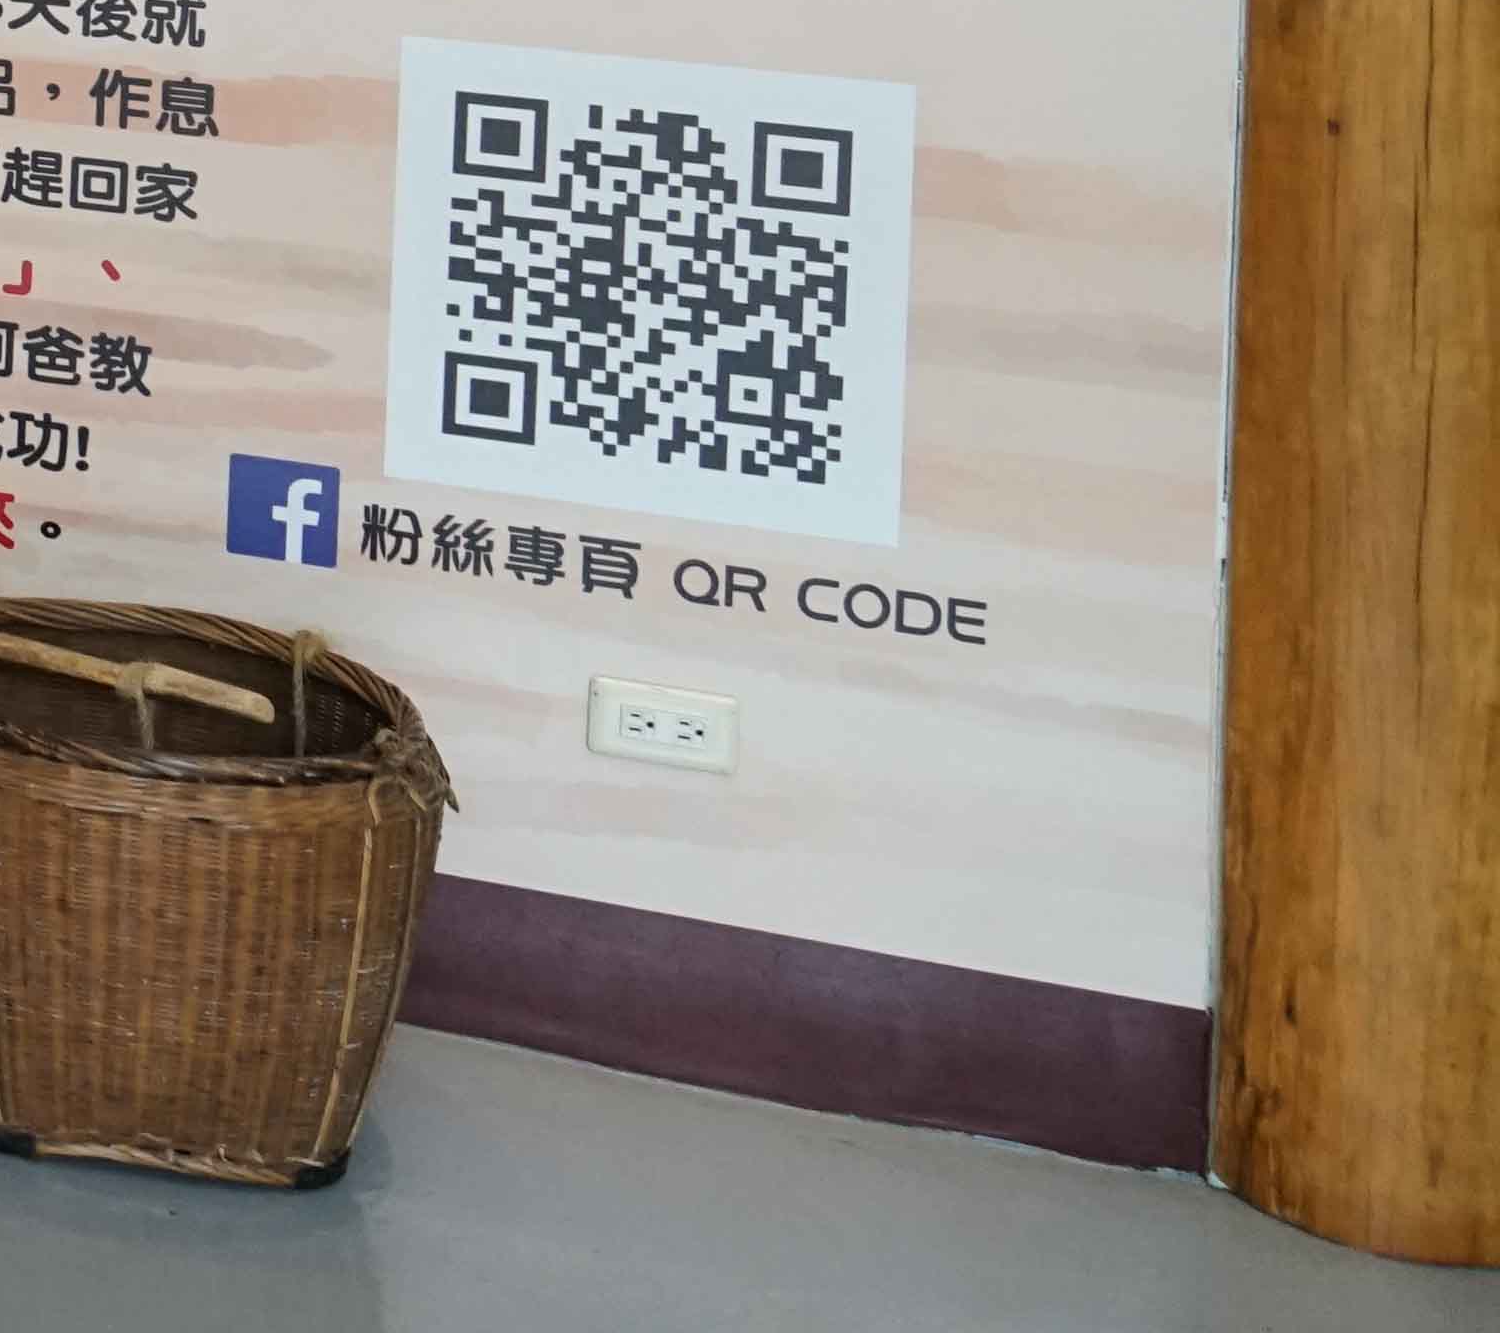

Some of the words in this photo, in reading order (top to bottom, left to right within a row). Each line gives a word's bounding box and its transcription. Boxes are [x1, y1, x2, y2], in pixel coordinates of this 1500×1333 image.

[361, 504, 642, 600] 粉絲專頁
[673, 559, 768, 613] QR
[796, 577, 988, 646] CODE
